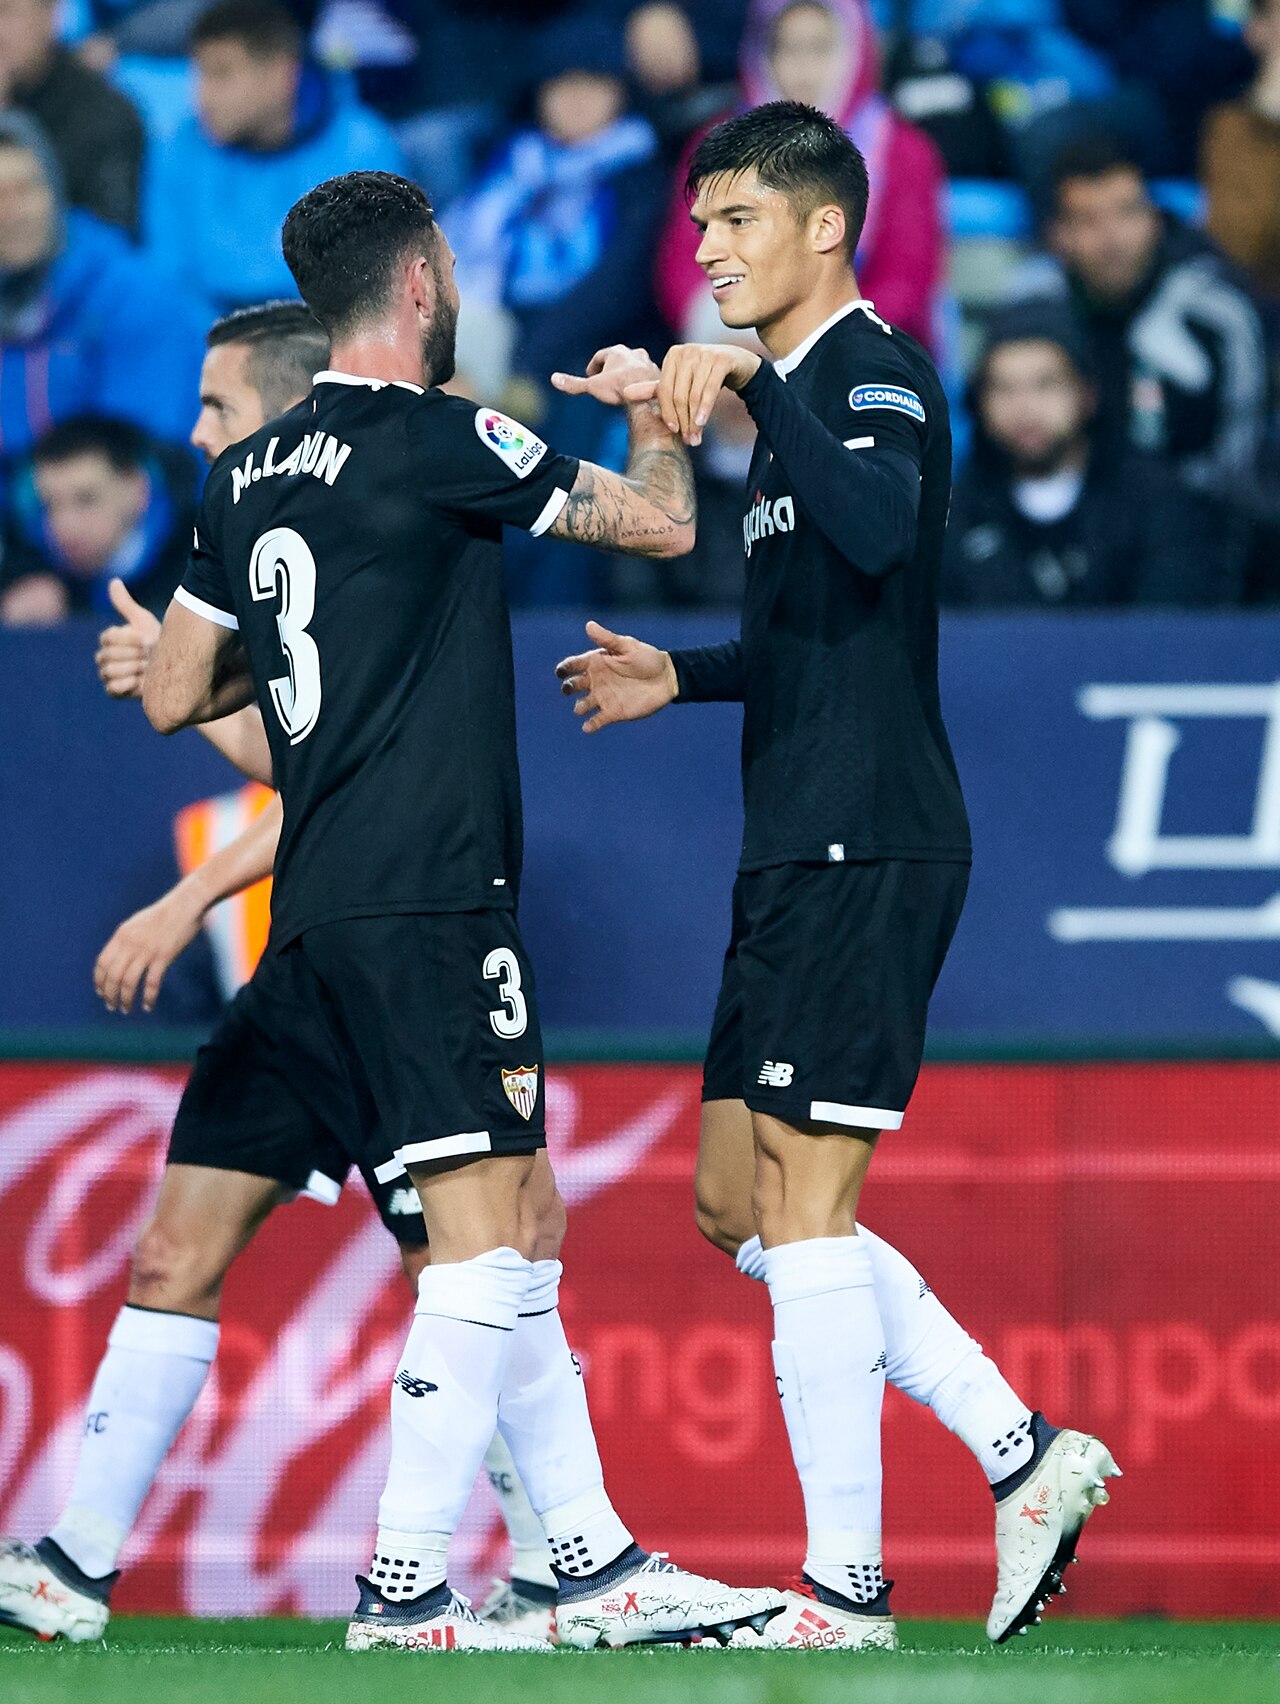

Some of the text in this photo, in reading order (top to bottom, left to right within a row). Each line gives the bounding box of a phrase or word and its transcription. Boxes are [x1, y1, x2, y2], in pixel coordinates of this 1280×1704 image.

[863, 390, 923, 415] CORDIALITY
[514, 442, 543, 471] LaLiga
[248, 526, 322, 747] 3
[482, 947, 528, 1040] 3
[796, 1626, 848, 1649] didas
